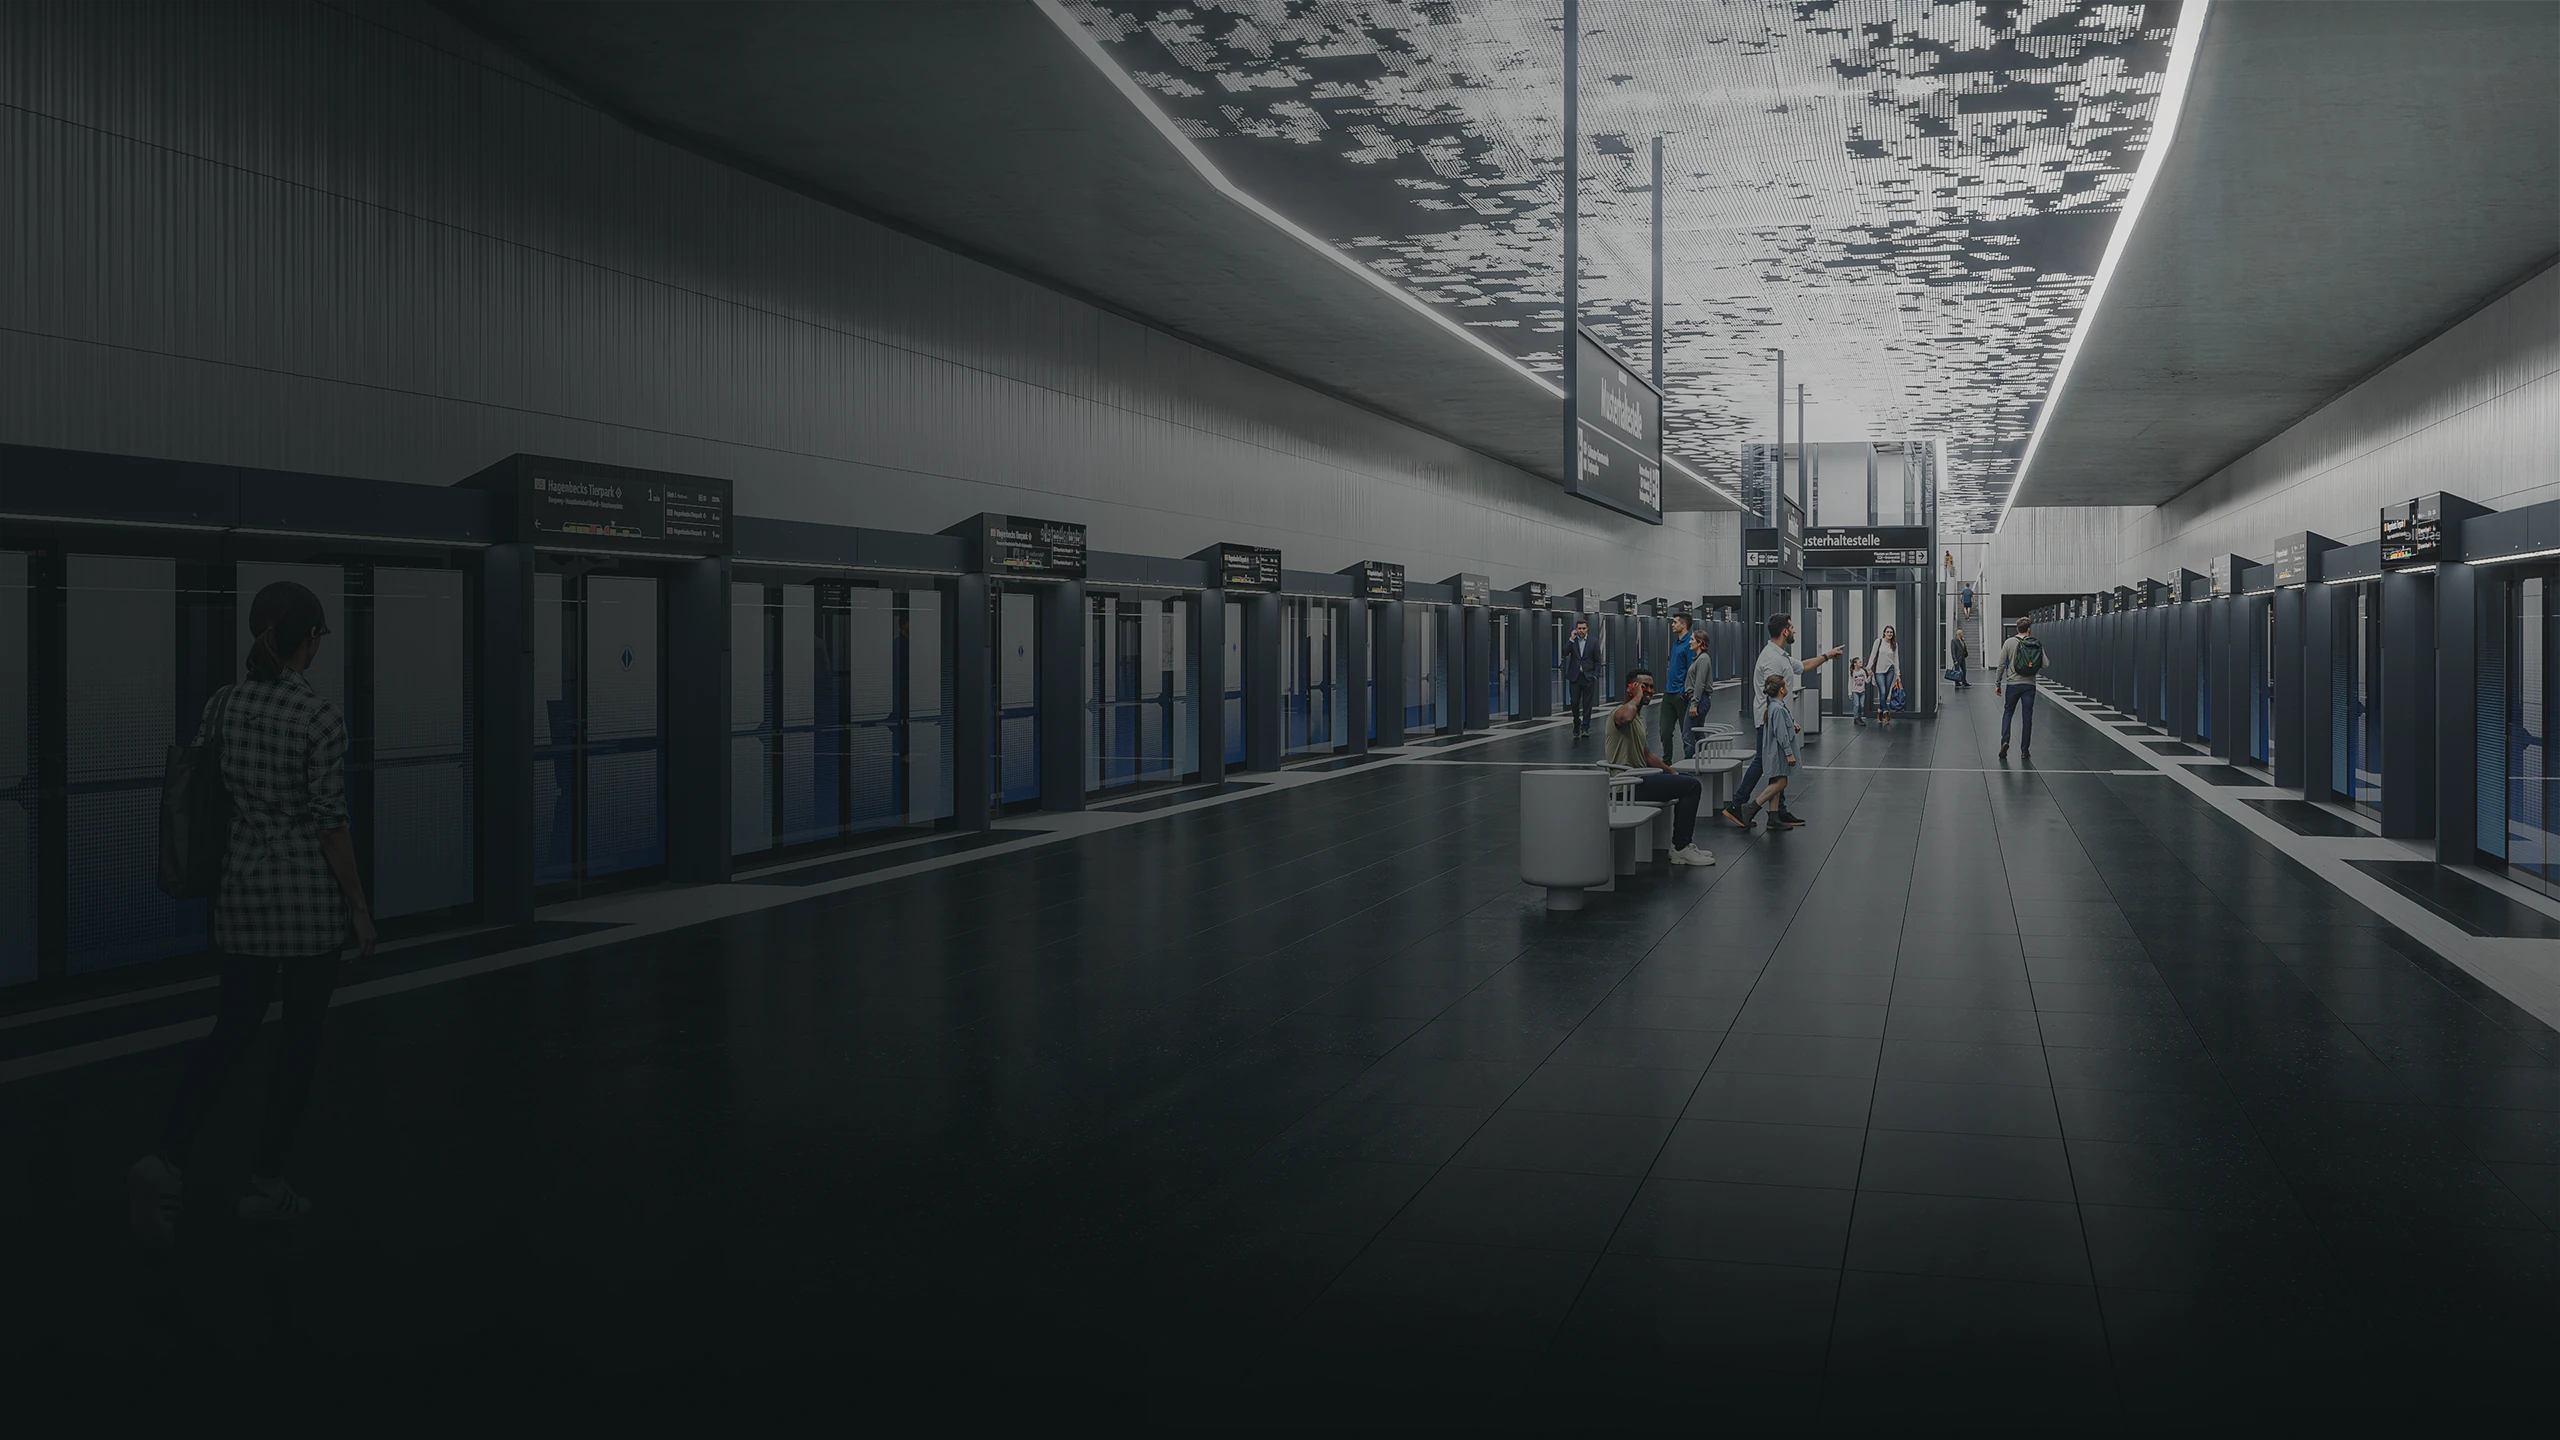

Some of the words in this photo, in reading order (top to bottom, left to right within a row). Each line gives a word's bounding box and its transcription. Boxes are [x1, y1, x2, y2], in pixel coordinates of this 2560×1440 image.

[548, 479, 588, 495] Hagenbecks
[588, 484, 615, 499] Tierpark
[1803, 533, 1881, 547] usterhaltestelle
